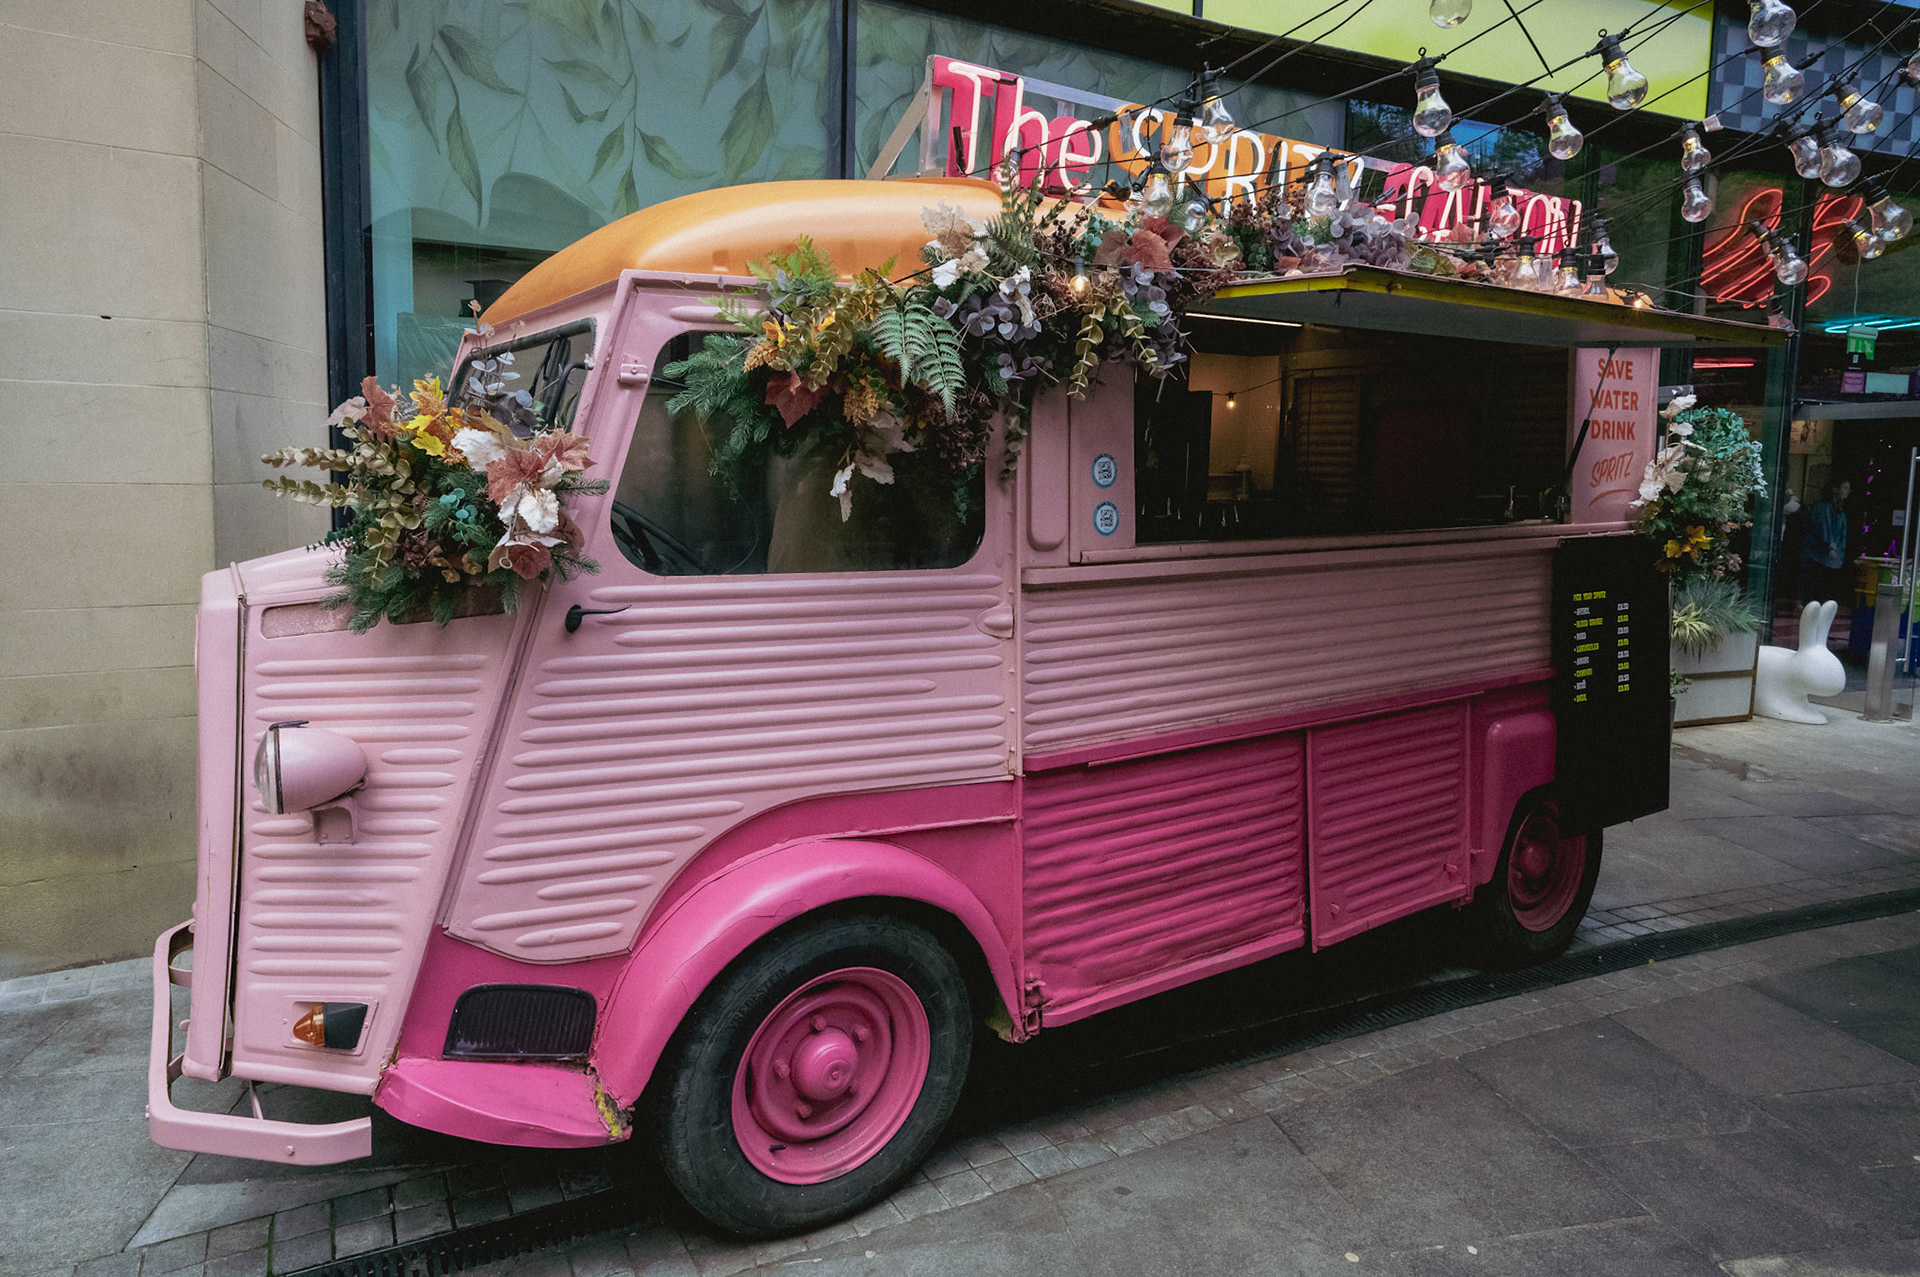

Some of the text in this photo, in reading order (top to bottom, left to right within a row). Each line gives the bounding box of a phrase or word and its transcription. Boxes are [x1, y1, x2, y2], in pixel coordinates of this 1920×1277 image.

[933, 56, 1102, 198] The
[1101, 104, 1365, 220] SPRITZ
[1597, 358, 1633, 381] SAVE
[1589, 388, 1639, 411] WATER
[1590, 420, 1636, 441] DRINK
[1589, 450, 1635, 488] SPRITZ
